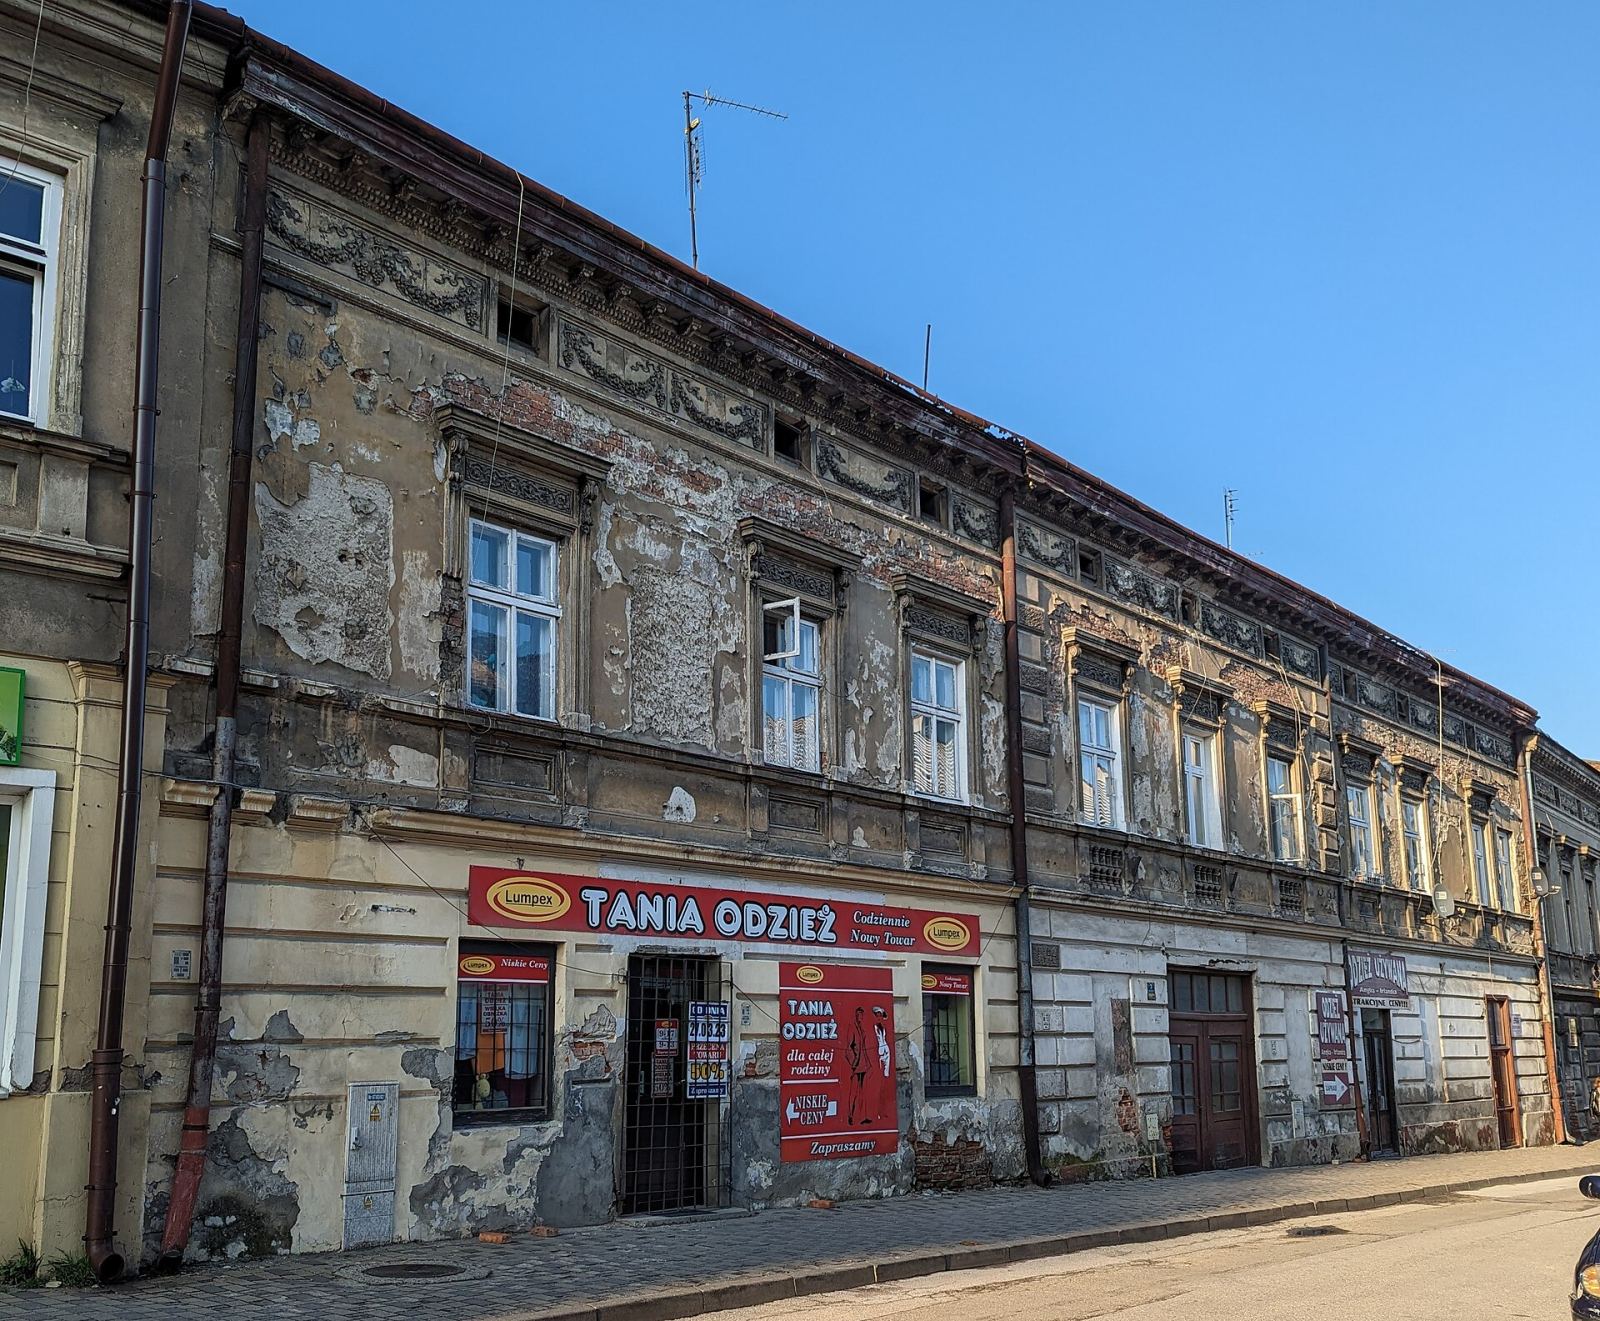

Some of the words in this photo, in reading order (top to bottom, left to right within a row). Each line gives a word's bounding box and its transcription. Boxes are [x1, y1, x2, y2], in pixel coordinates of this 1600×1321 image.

[505, 889, 553, 907] Lumpex
[581, 888, 704, 934] TANIA
[714, 899, 837, 943] ODZIEŻ
[853, 911, 910, 928] Codziennie
[850, 929, 881, 947] Nowy
[884, 932, 915, 946] Towar
[933, 926, 961, 940] Lumpex
[501, 958, 527, 969] Niskie
[529, 960, 549, 971] Ceny
[939, 981, 953, 989] Nowy
[787, 1000, 834, 1016] TANIA
[1353, 998, 1386, 1007] TRAKCYJNE
[782, 1019, 838, 1041] ODZIEŻ
[787, 1050, 805, 1061] dla
[808, 1049, 834, 1063] całej
[791, 1062, 831, 1076] rodziny
[795, 1094, 828, 1109] NISKIE
[800, 1110, 825, 1125] CENY
[810, 1140, 876, 1157] Zapraszamy
